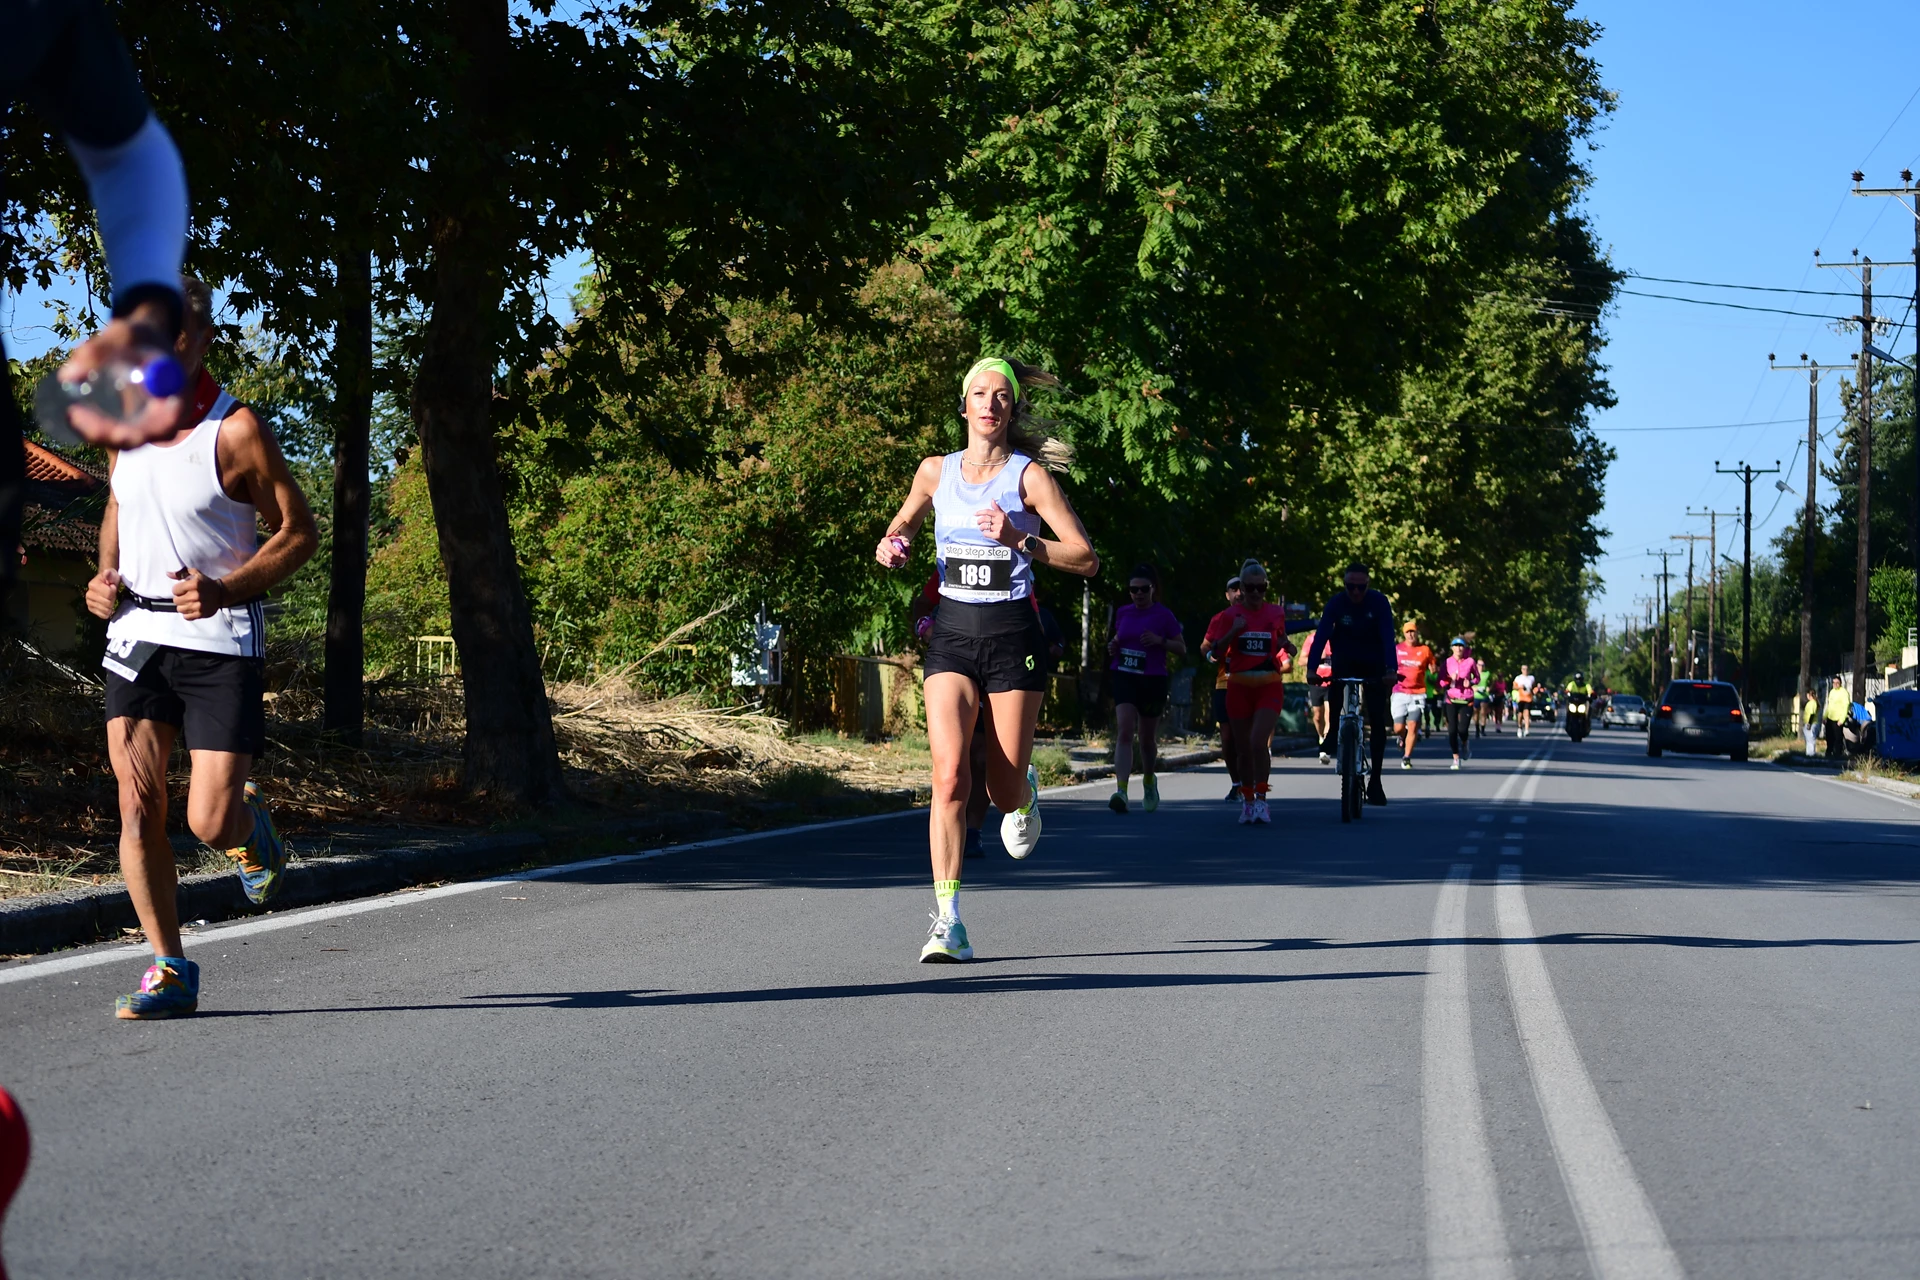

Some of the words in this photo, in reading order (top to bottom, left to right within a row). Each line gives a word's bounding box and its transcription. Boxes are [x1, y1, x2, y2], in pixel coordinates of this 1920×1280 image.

[946, 546, 963, 556] step
[965, 546, 985, 558] step
[987, 547, 1009, 558] step
[959, 564, 991, 586] 189
[1246, 640, 1264, 650] 334
[1124, 656, 1138, 667] 284
